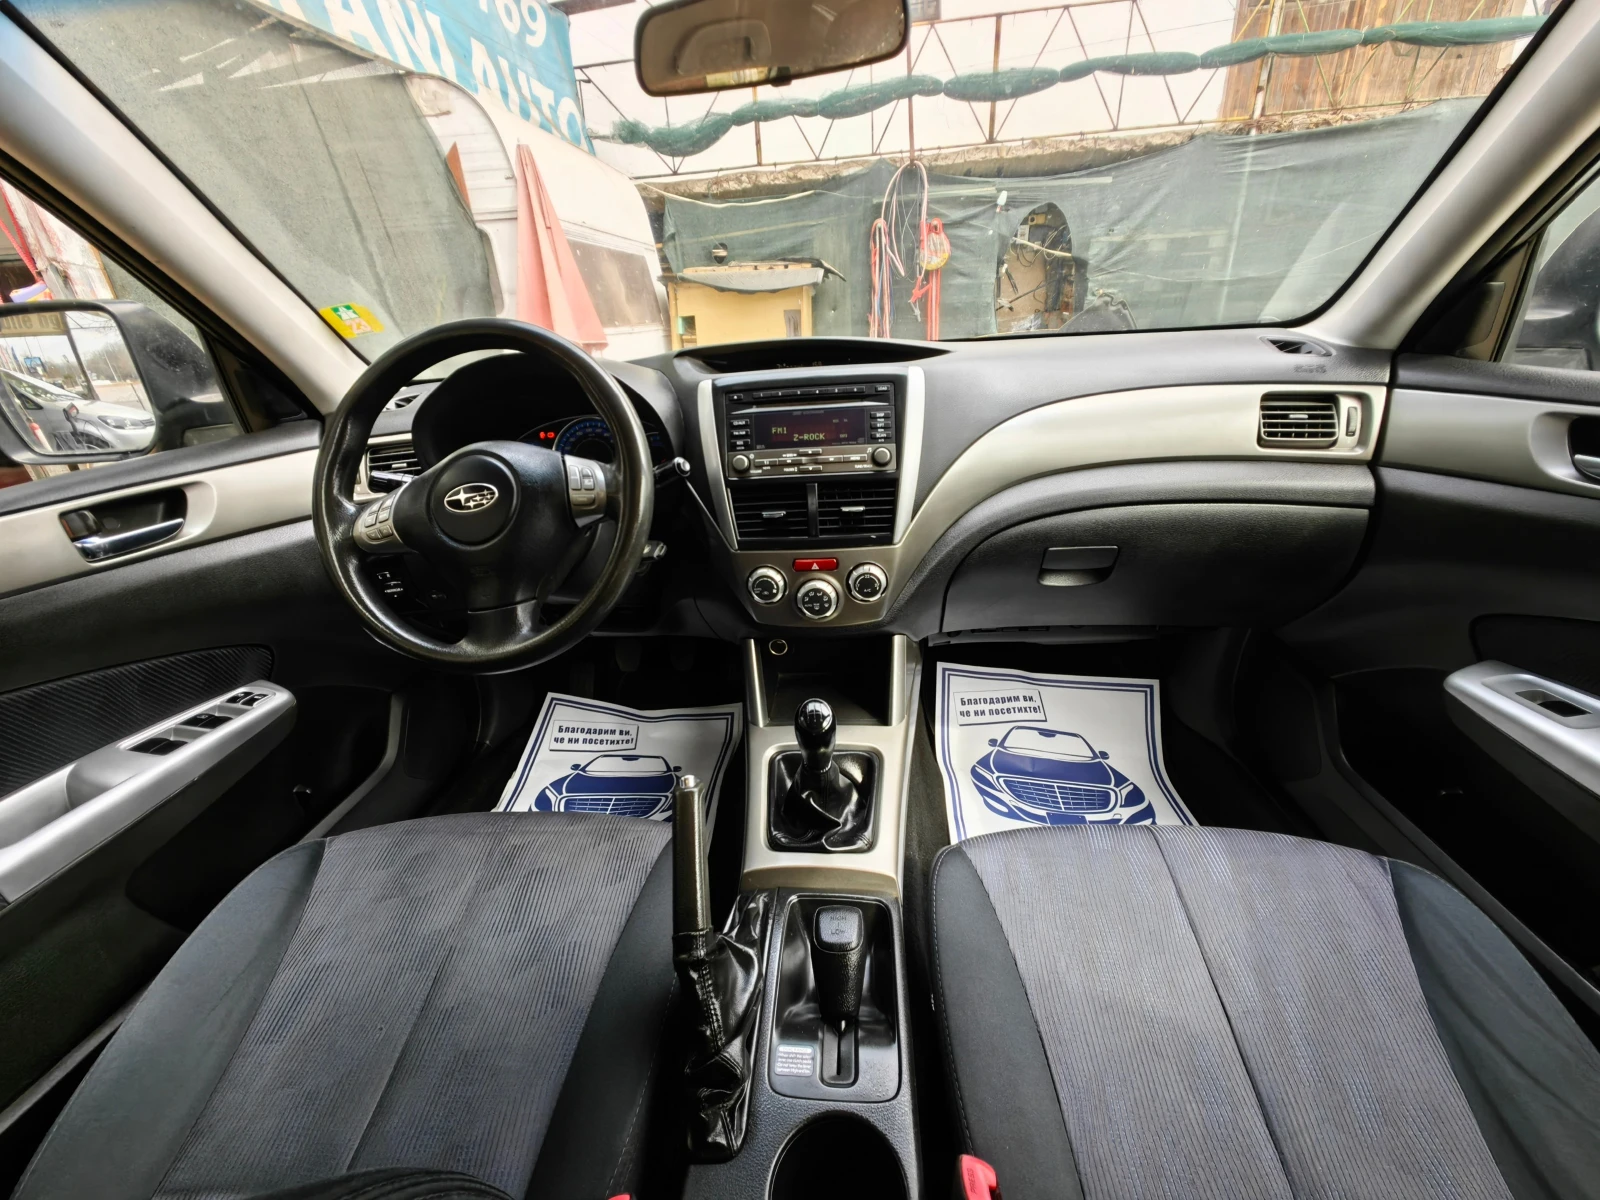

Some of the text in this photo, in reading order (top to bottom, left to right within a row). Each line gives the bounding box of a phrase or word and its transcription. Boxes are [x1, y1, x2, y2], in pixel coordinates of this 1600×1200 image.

[470, 37, 590, 154] AUTO
[771, 426, 787, 434] FM1
[960, 695, 1037, 706] Благодарим ви,
[960, 705, 1042, 718] че ни посетихте!
[558, 725, 617, 736] Благодарим
[553, 736, 565, 744] че
[582, 737, 635, 745] посетихте!
[966, 1167, 977, 1195] PRESS
